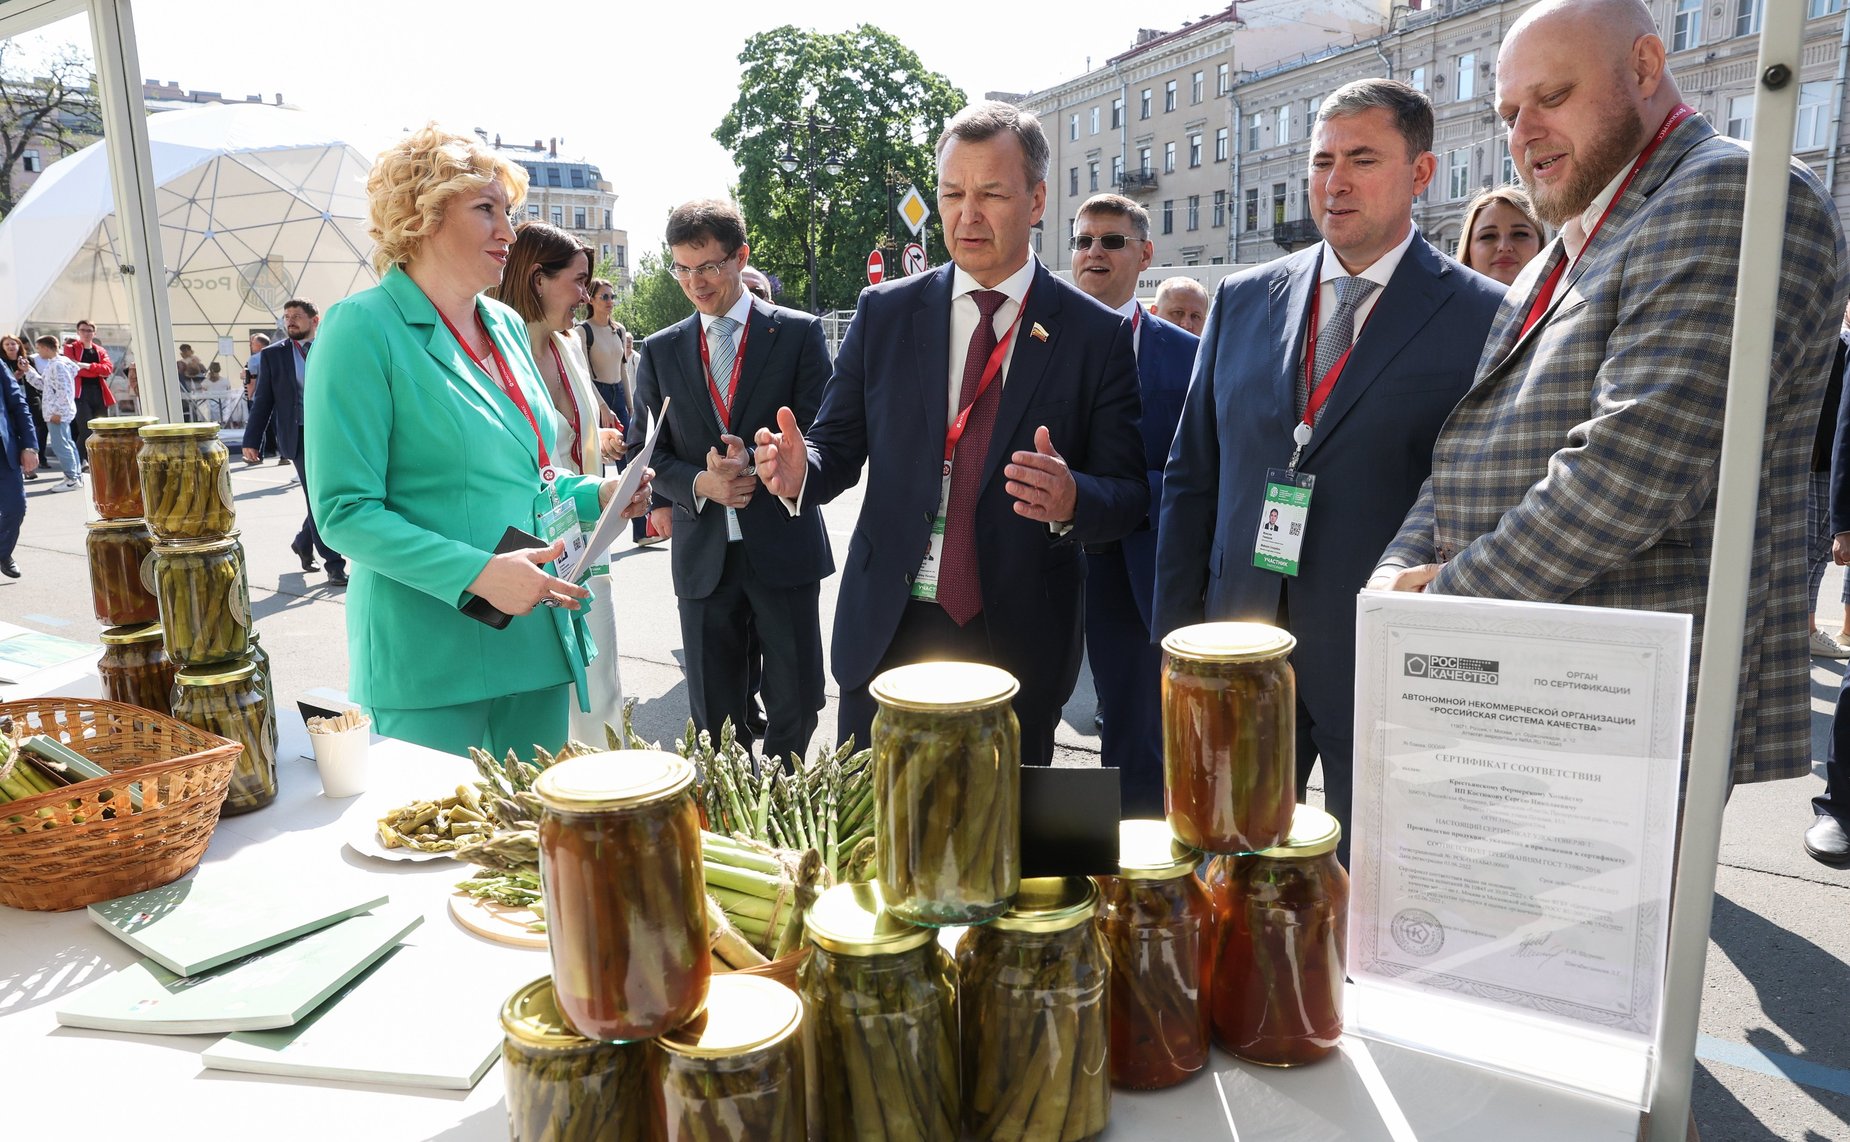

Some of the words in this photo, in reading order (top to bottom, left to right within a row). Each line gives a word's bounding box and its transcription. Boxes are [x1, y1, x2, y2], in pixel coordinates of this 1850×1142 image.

[1431, 656, 1456, 667] РОС
[1430, 668, 1497, 684] КАЧЕСТВО
[1566, 671, 1598, 680] ОРГАН
[1533, 678, 1547, 686] ПО
[1550, 680, 1630, 695] СЕРТИФИКАЦИИ
[1401, 691, 1465, 706] АВТОНОМНОЙ
[1468, 698, 1558, 716] НЕКОММЕРЧЕСКОЙ
[1561, 710, 1635, 726] ОРГАНИЗАЦИИ
[1429, 704, 1496, 719] «РОССИЙСКАЯ
[1499, 714, 1544, 725] СИСТЕМА
[1547, 719, 1601, 732] КАЧЕСТВА»
[1435, 753, 1507, 770] СЕРТИФИКАТ
[1510, 763, 1601, 783] СООТВЕТСТВИЯ
[1543, 859, 1561, 867] ГОСТ
